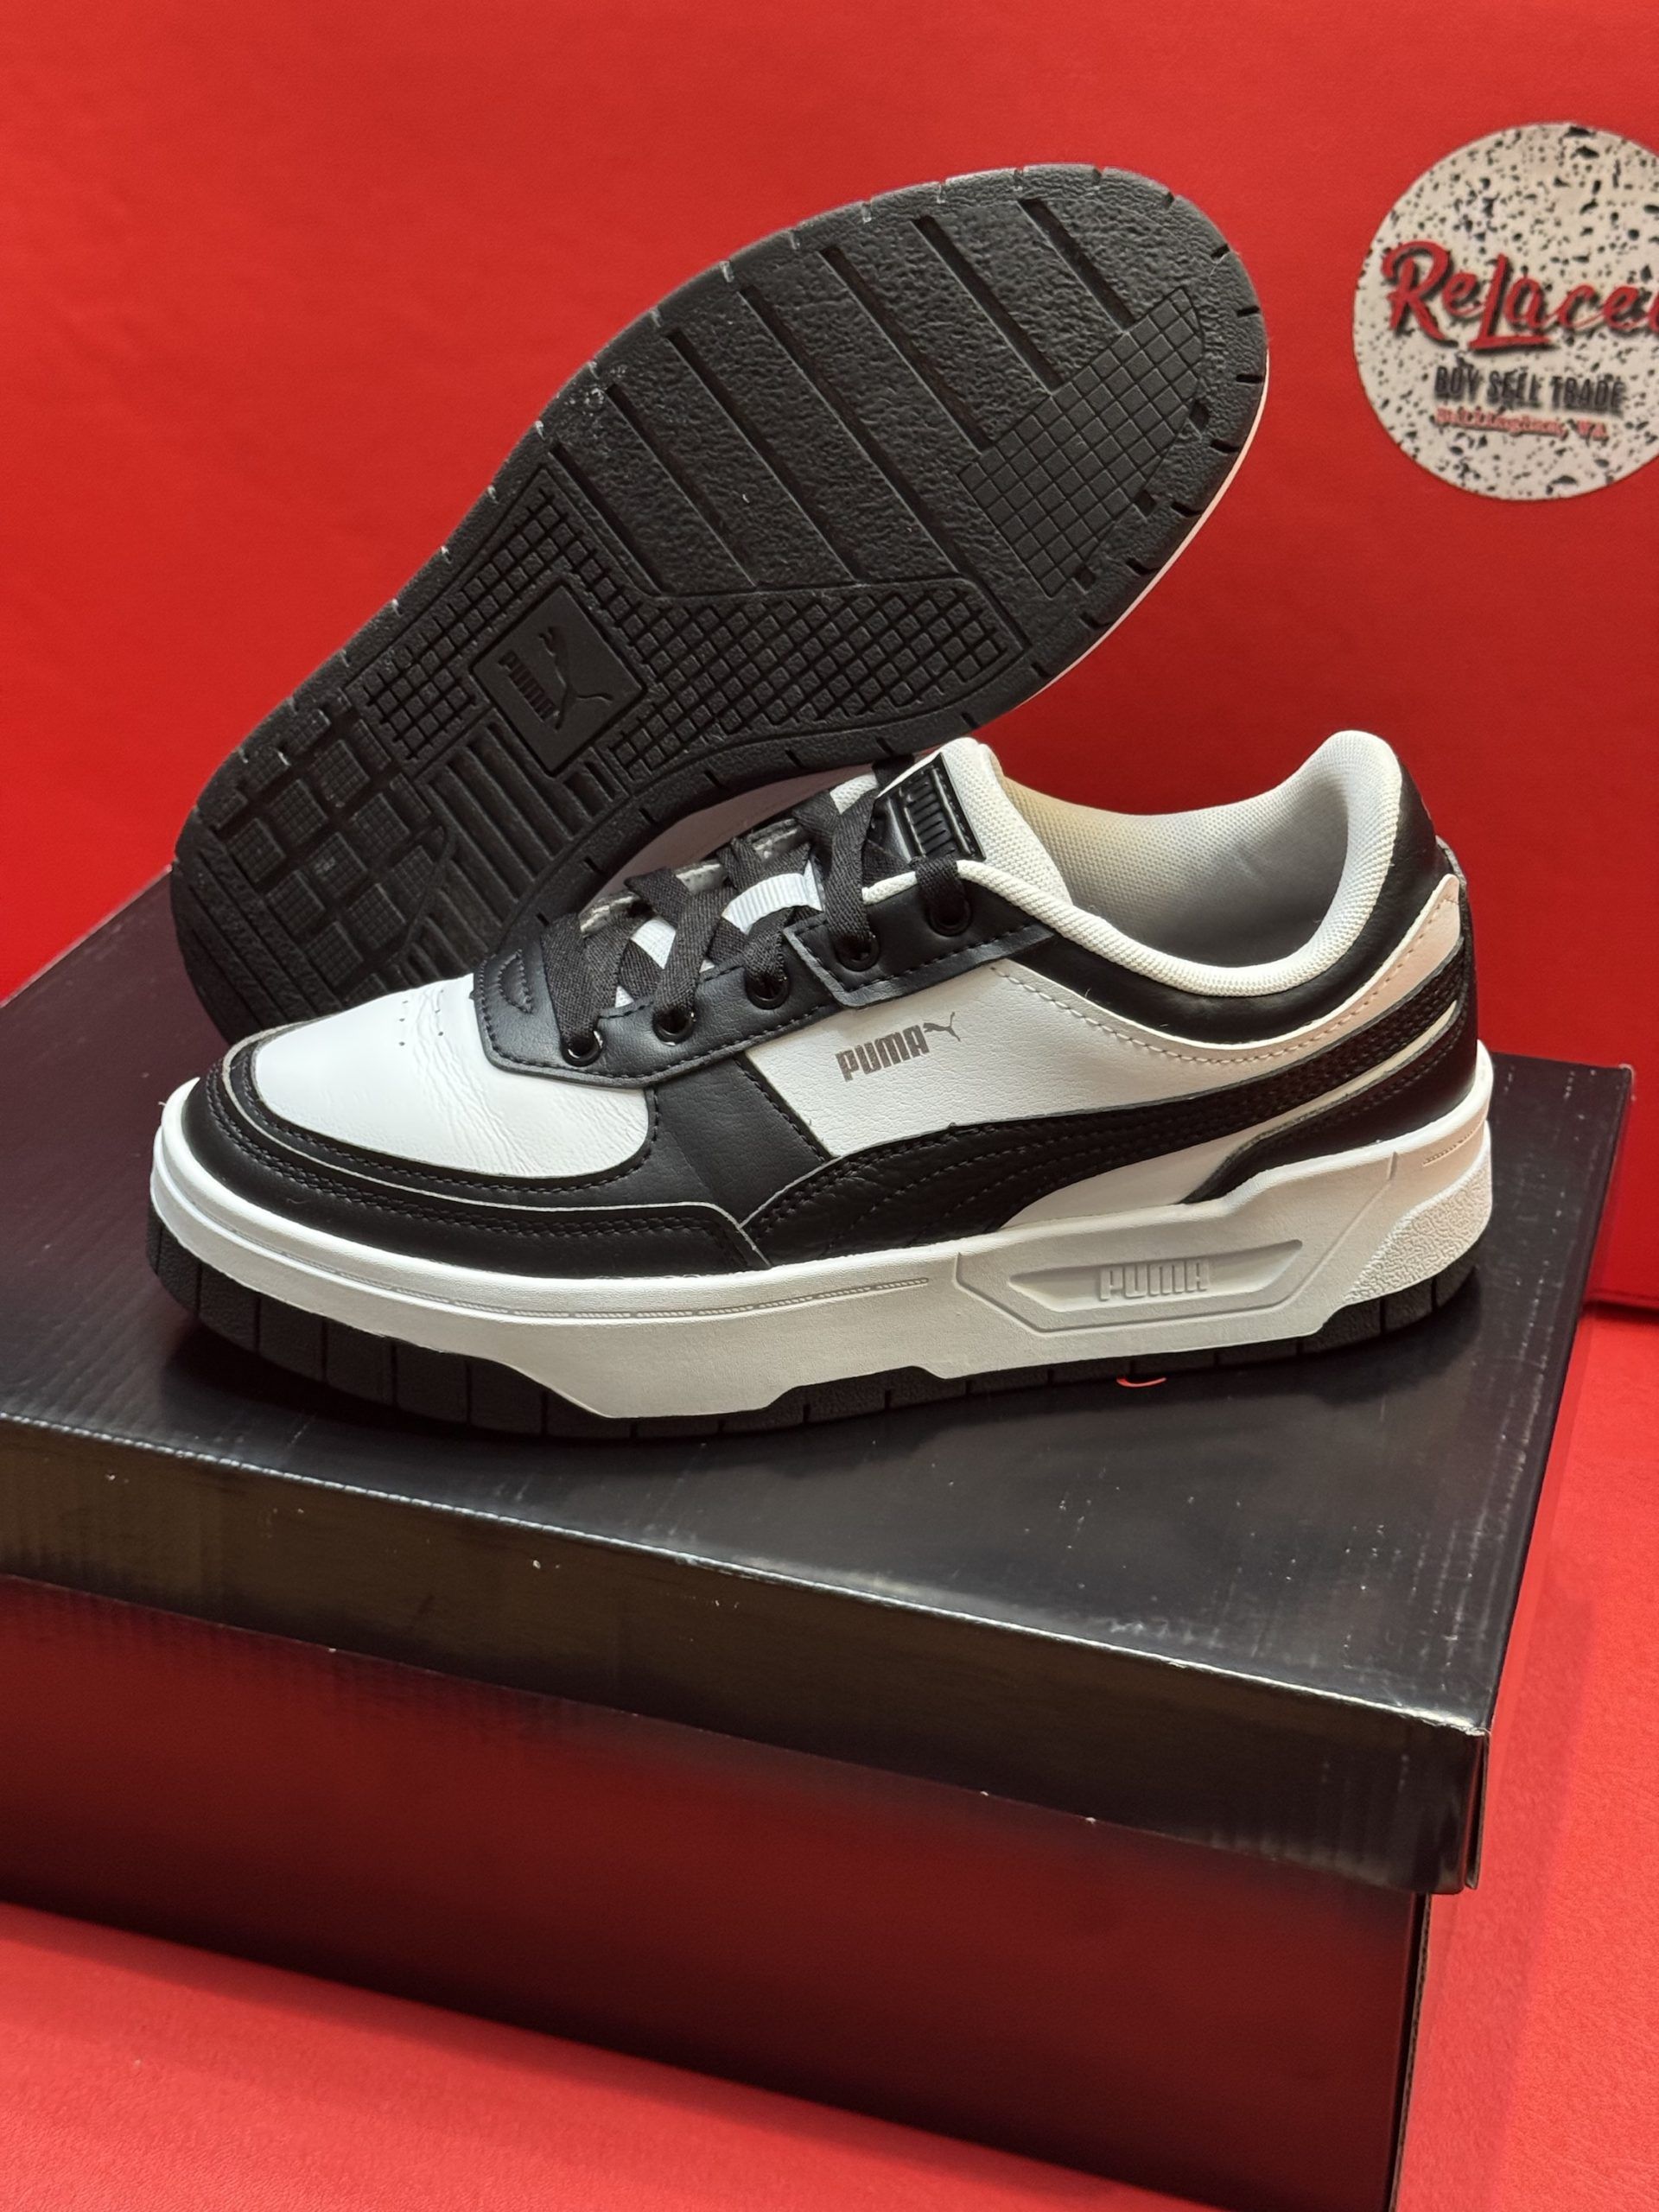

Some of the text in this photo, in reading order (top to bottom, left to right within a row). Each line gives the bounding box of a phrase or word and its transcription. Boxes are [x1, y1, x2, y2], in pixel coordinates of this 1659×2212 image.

[1382, 240, 1659, 351] ReLace
[1487, 370, 1542, 407] SELL
[1550, 375, 1624, 415] TRADE
[499, 651, 560, 722] PUMA
[836, 1025, 929, 1082] PUMA
[1099, 1259, 1210, 1301] PUMA
